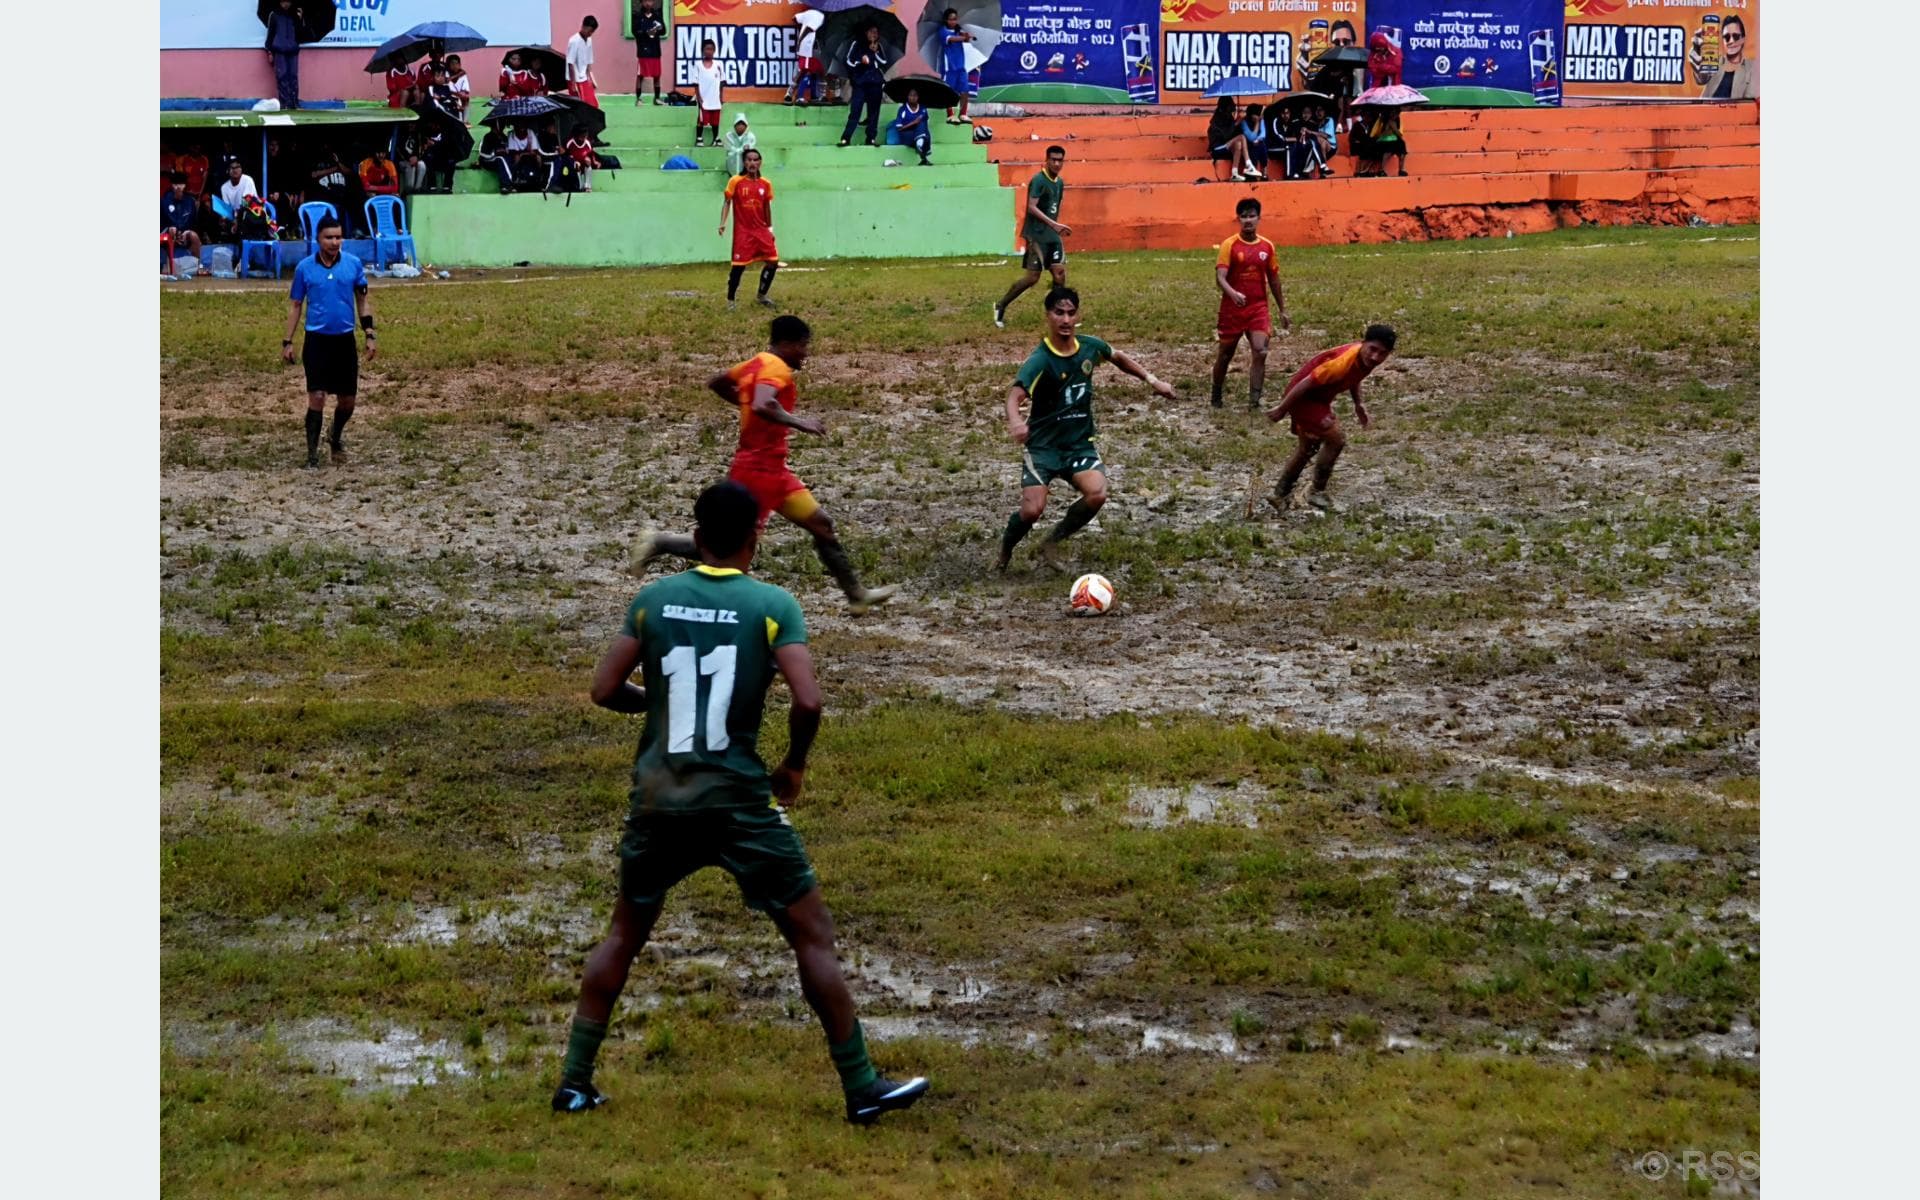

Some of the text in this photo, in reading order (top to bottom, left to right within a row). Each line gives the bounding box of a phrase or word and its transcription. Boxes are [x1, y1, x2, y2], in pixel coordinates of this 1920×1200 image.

[340, 16, 376, 31] DEAL
[676, 26, 796, 59] MAX TIGE
[1166, 33, 1290, 64] MAX TIGER
[1567, 26, 1683, 57] MAX TIGER
[1566, 57, 1682, 81] ENERGY DRINK
[1065, 382, 1087, 405] 17
[661, 645, 737, 753] 11
